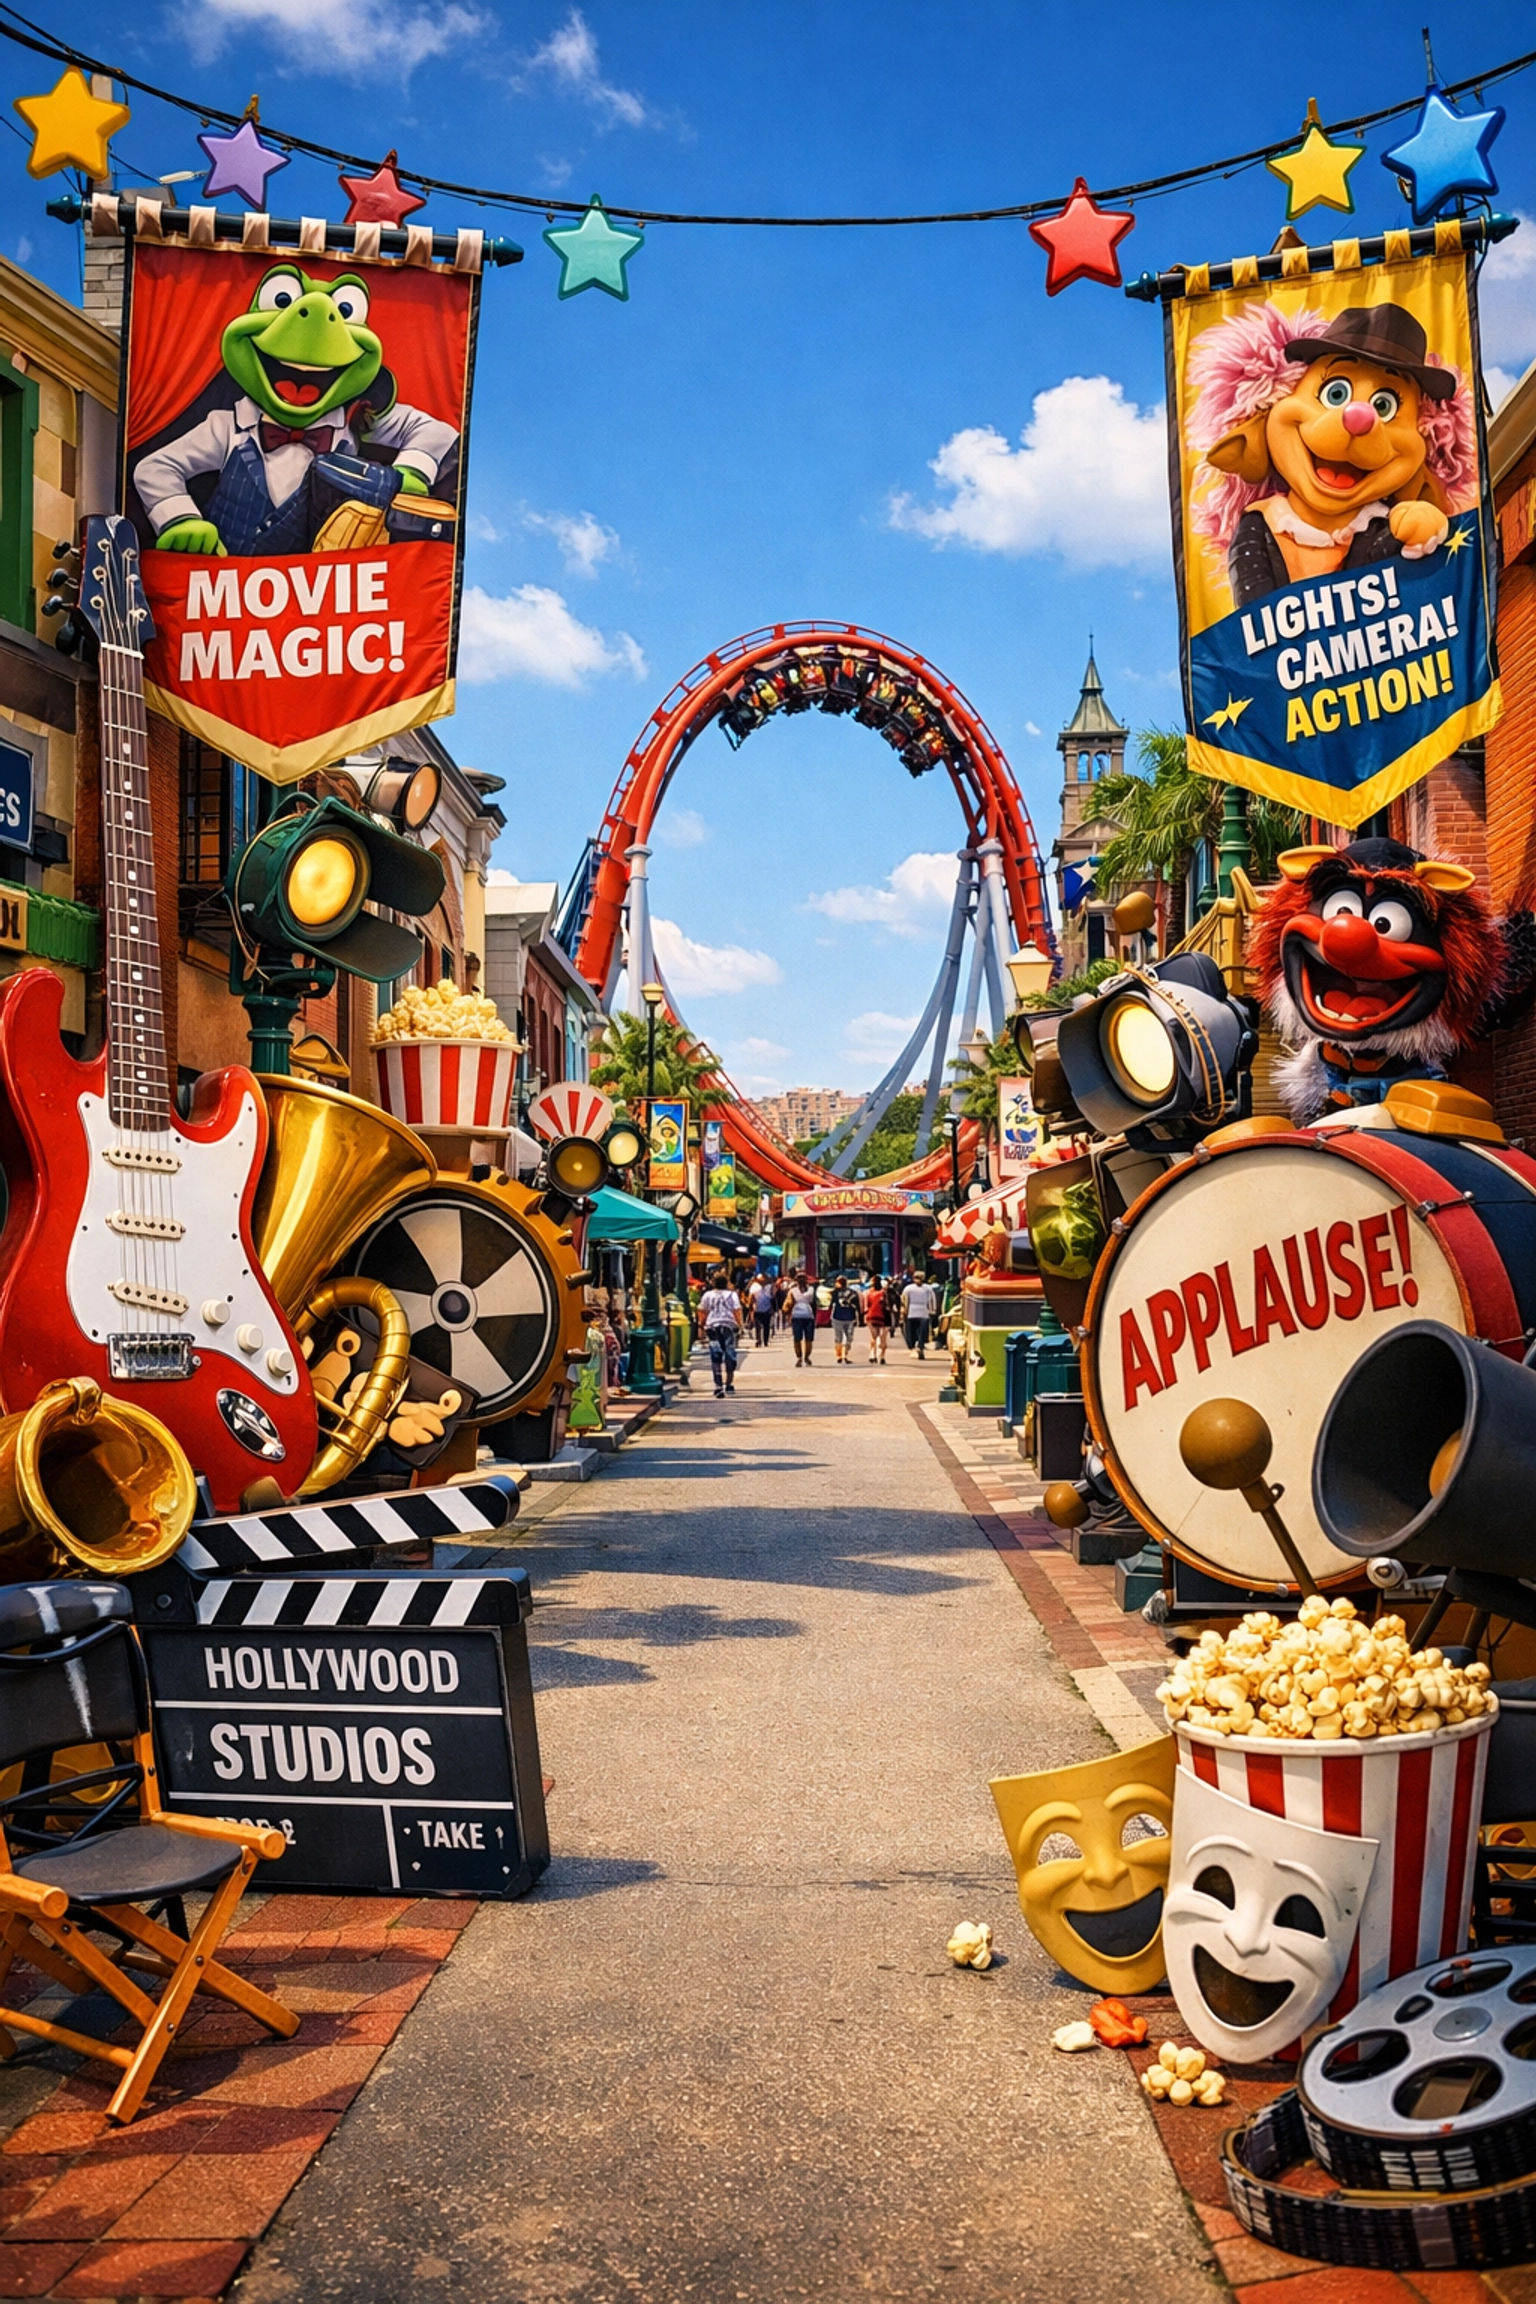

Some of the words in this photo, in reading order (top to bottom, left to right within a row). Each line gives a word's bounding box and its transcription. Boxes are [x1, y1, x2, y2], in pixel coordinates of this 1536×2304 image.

[187, 560, 388, 620] MOVIE
[1241, 566, 1400, 655] LIGHTS!
[180, 621, 405, 681] MAGIC!
[1277, 595, 1459, 690] CAMERA!
[1286, 649, 1453, 743] ACTION!
[1120, 1204, 1418, 1413] APPLAUSE!
[204, 1647, 459, 1693] HOLLYWOOD
[210, 1722, 436, 1786] STUDIOS
[417, 1820, 486, 1849] TAKE
